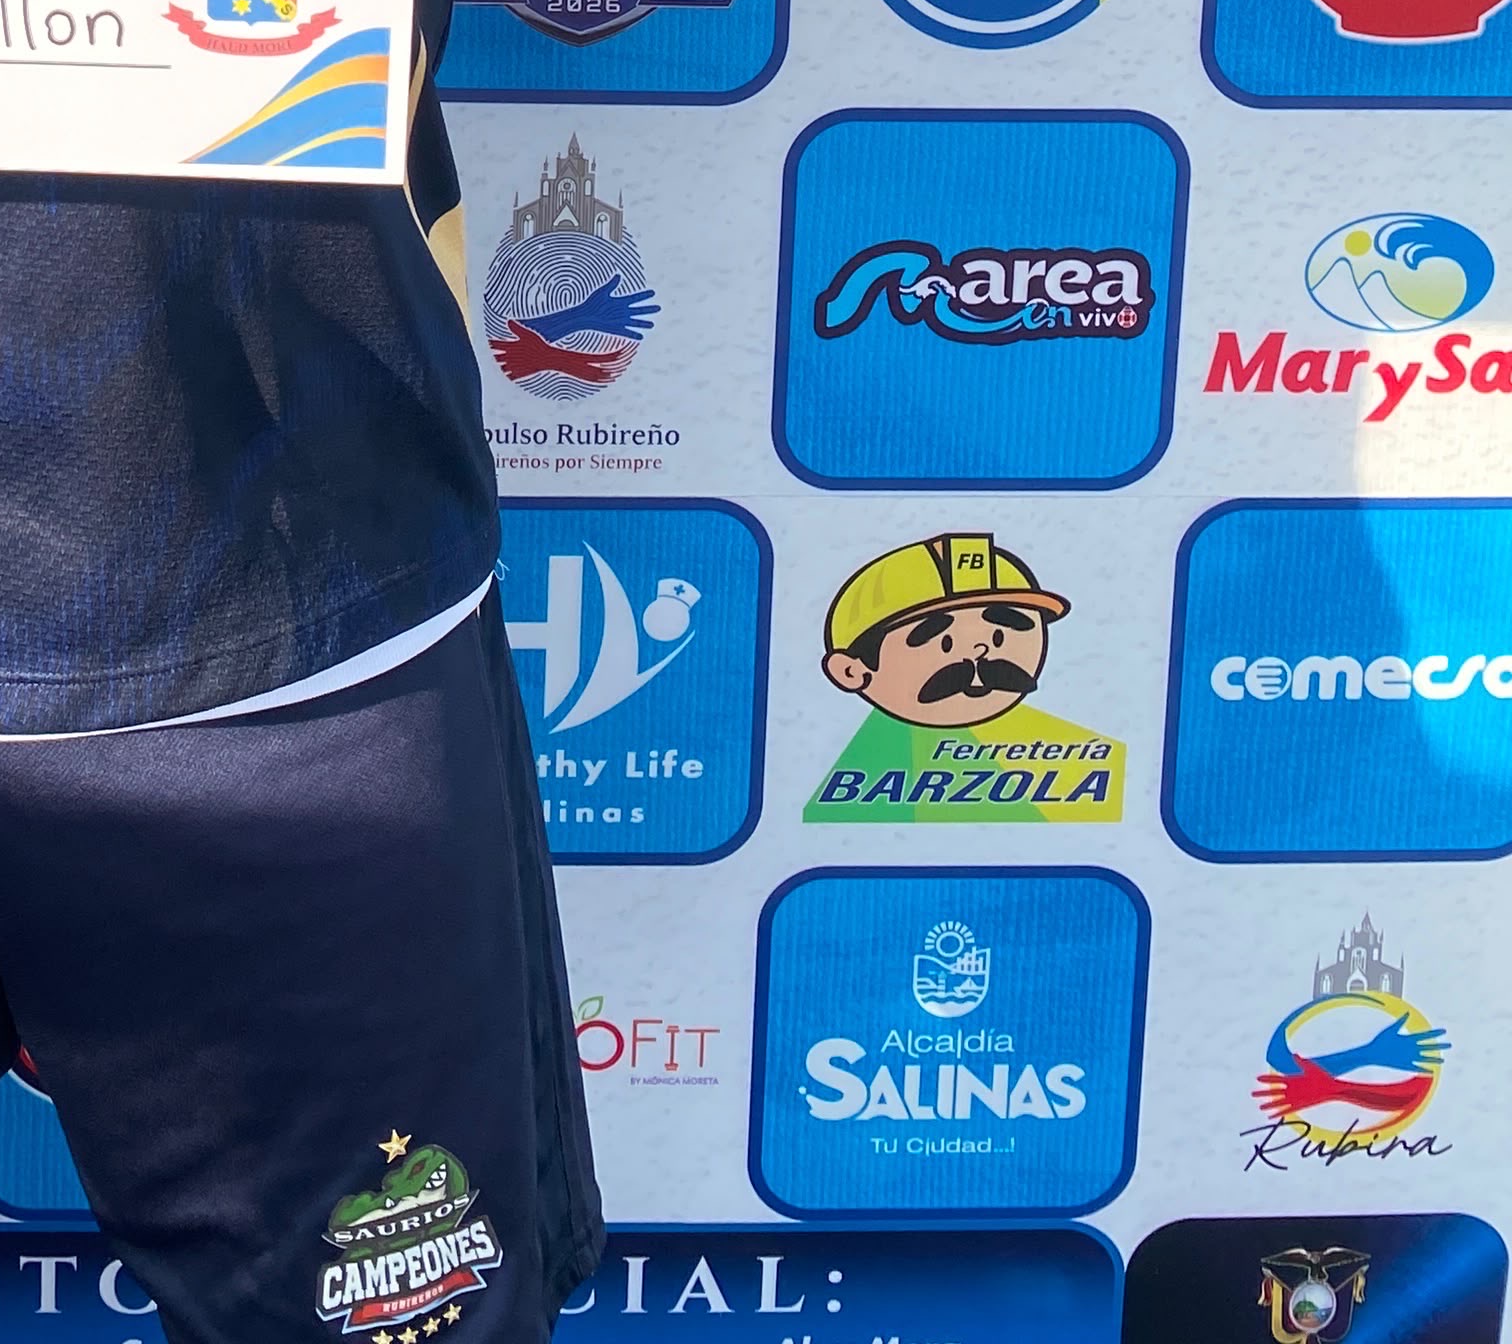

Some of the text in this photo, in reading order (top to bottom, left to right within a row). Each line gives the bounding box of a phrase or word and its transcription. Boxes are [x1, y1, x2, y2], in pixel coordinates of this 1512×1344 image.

[961, 259, 1143, 305] area
[556, 424, 680, 445] Rubireño
[496, 453, 662, 473] ireños por Siempre
[957, 552, 984, 571] FB
[932, 738, 1112, 761] Ferretería
[537, 749, 704, 787] thy Life
[819, 770, 1110, 803] BARZOLA
[543, 800, 645, 823] linas
[881, 1029, 1014, 1058] Alcaldía
[806, 1038, 1086, 1120] SALINAS
[334, 1194, 470, 1242] SAURIOS
[322, 1220, 496, 1310] CAMPEONES
